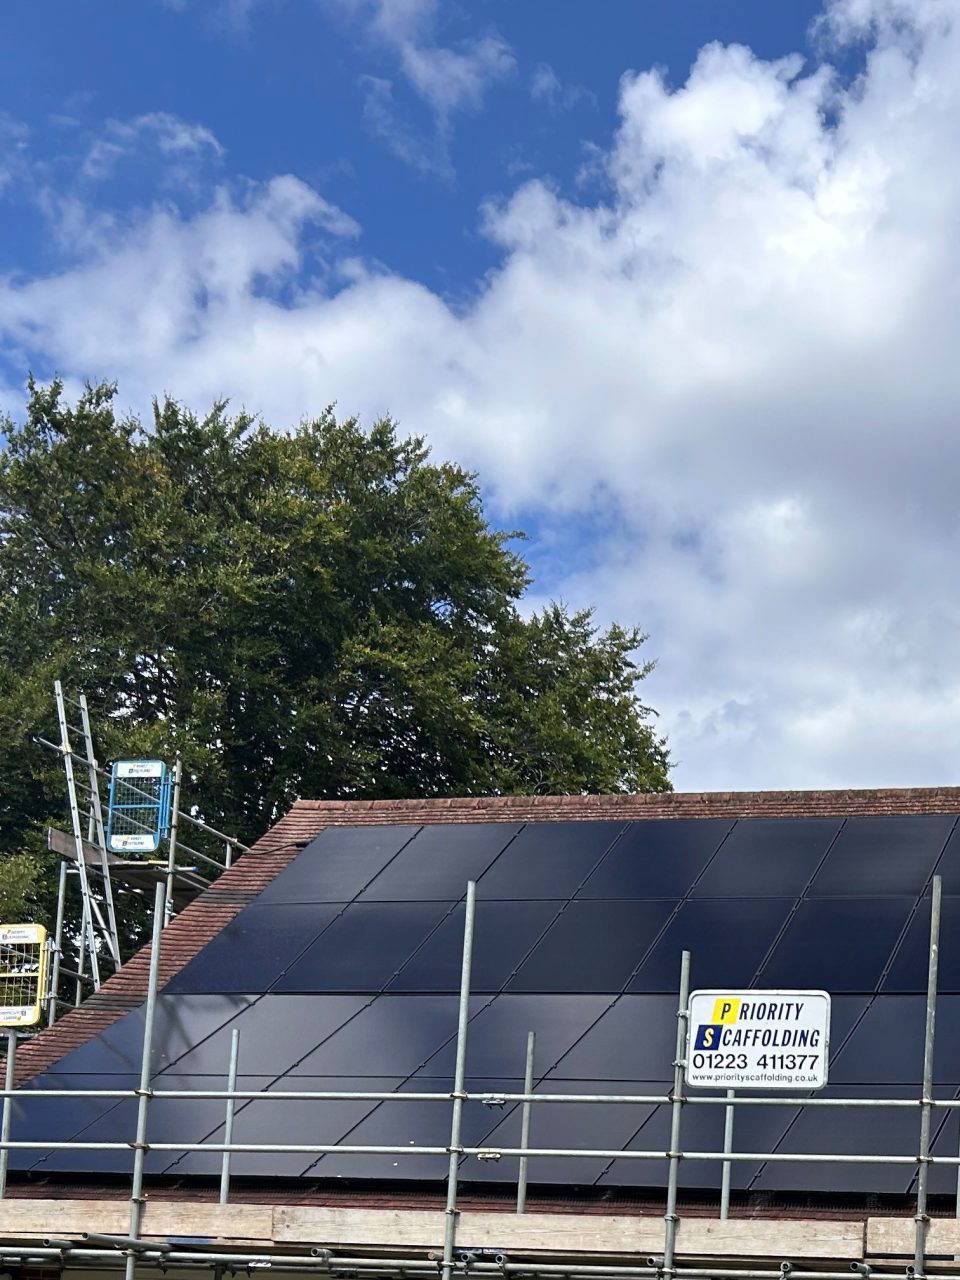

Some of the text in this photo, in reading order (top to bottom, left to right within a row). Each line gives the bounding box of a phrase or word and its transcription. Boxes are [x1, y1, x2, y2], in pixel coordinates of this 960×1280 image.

[720, 1002, 805, 1021] PRIORITY
[702, 1027, 820, 1048] SCAFFOLDING
[692, 1053, 820, 1070] 01223 411377
[692, 1073, 818, 1082] www.priorityscaffolding.co.uk
